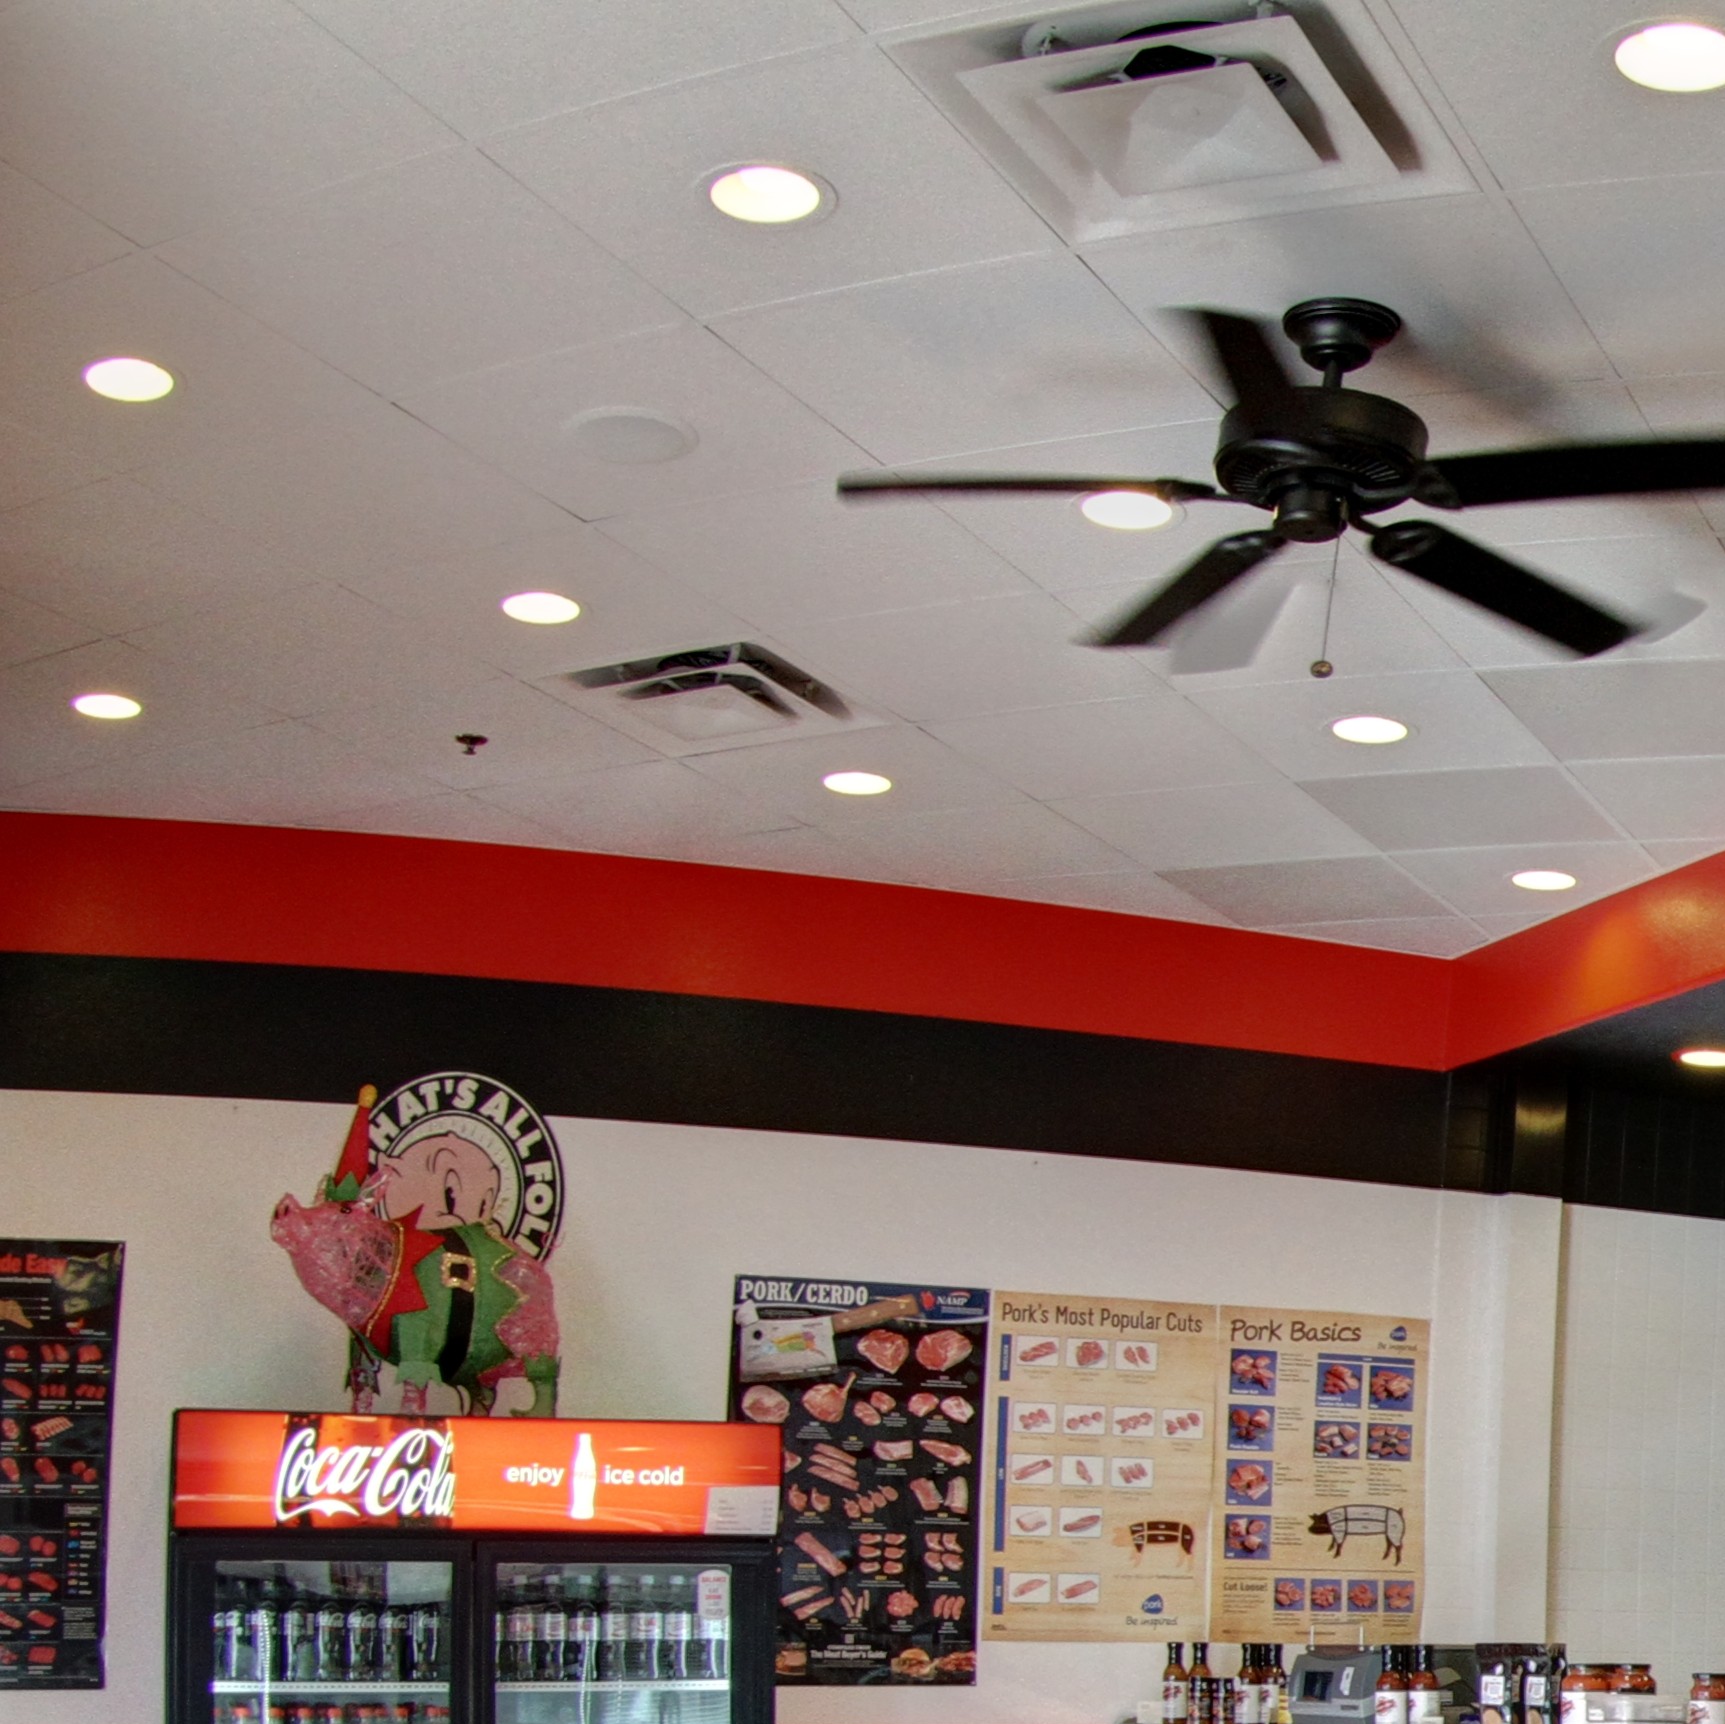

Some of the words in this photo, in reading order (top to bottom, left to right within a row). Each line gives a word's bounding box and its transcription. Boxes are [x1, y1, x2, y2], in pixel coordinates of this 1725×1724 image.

[369, 1079, 480, 1165] HAT'S
[478, 1091, 542, 1160] ALL
[513, 1160, 554, 1257] FOL
[740, 1279, 868, 1306] PORK/CERDO
[1002, 1302, 1049, 1324] Pork's
[1056, 1306, 1094, 1327] Most
[1100, 1308, 1160, 1333] Popular
[1166, 1312, 1203, 1333] Cuts
[1230, 1319, 1282, 1343] Pork
[1290, 1321, 1361, 1343] Basics
[275, 1427, 457, 1522] Coca-Cola
[505, 1463, 564, 1487] enjoy
[604, 1464, 635, 1485] ice
[639, 1464, 685, 1485] cold
[1126, 1615, 1136, 1625] Be
